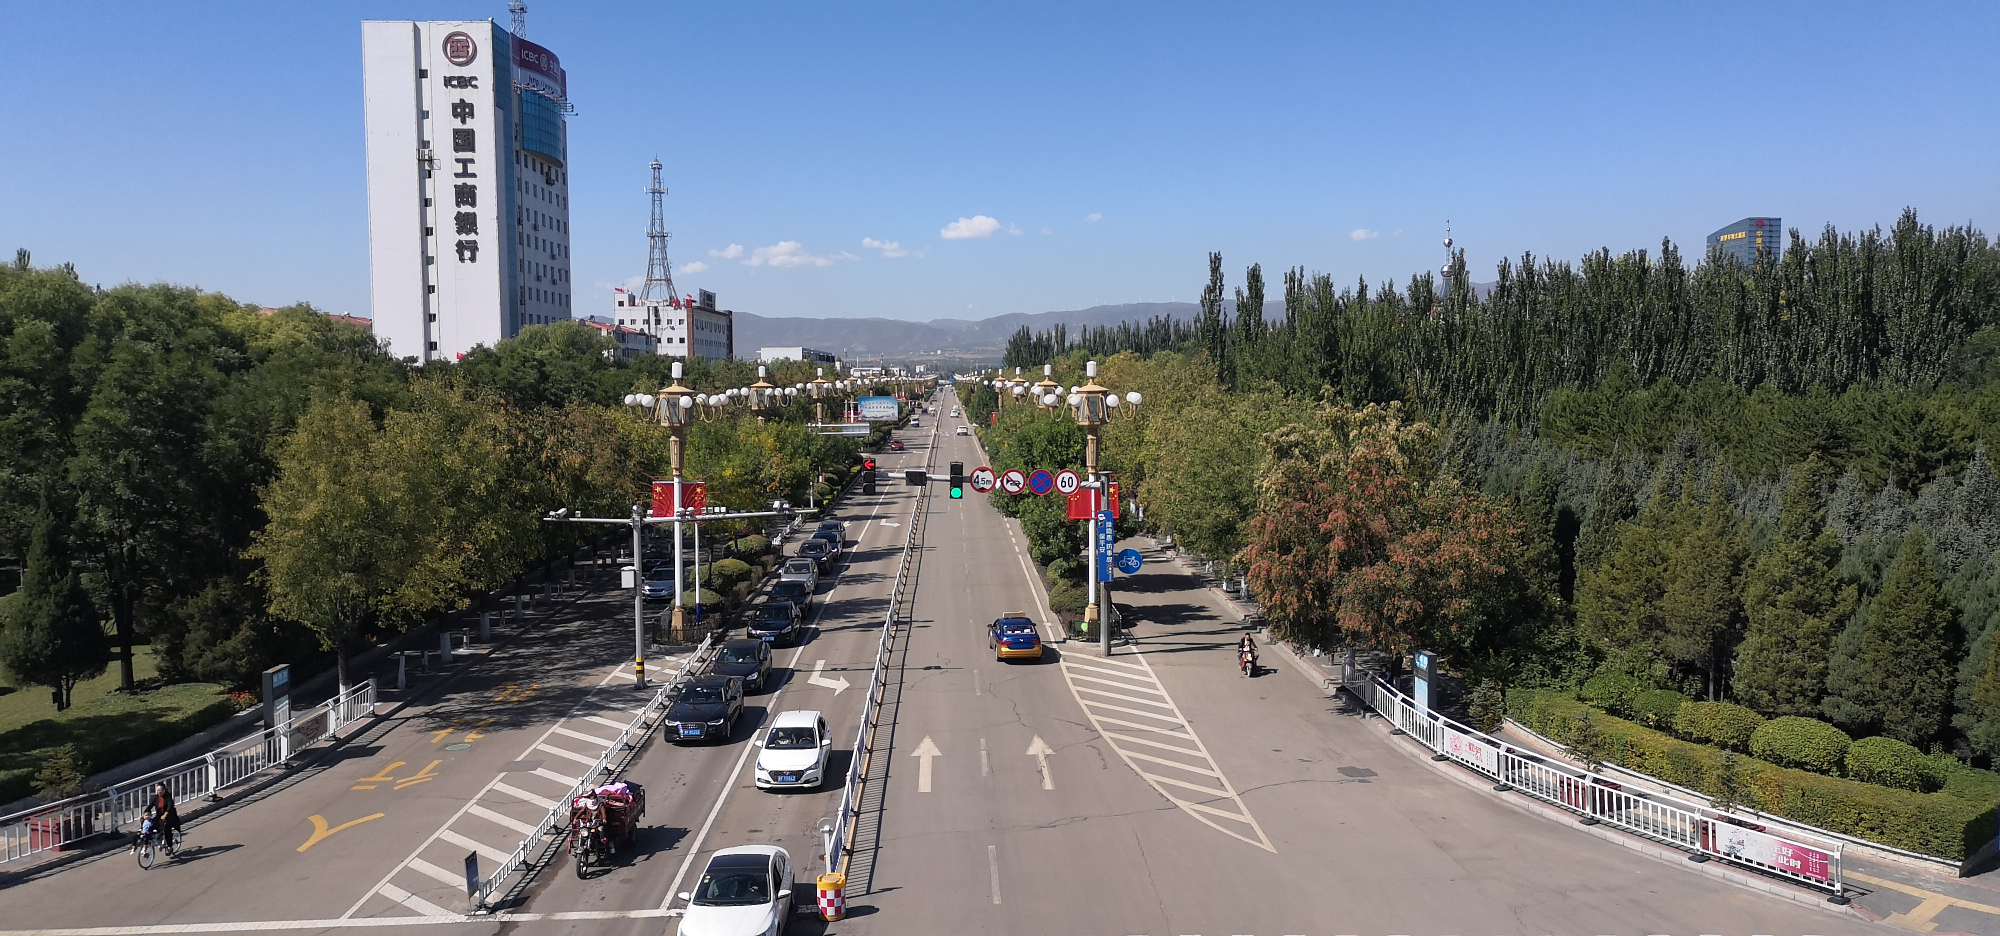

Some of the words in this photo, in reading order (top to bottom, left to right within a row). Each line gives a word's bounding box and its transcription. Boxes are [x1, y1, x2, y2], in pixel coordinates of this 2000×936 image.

[521, 48, 539, 64] ICBC
[443, 75, 479, 89] ICBC
[451, 98, 479, 263] 中国工商银行
[973, 474, 992, 486] 4.5m
[1060, 476, 1074, 488] 60
